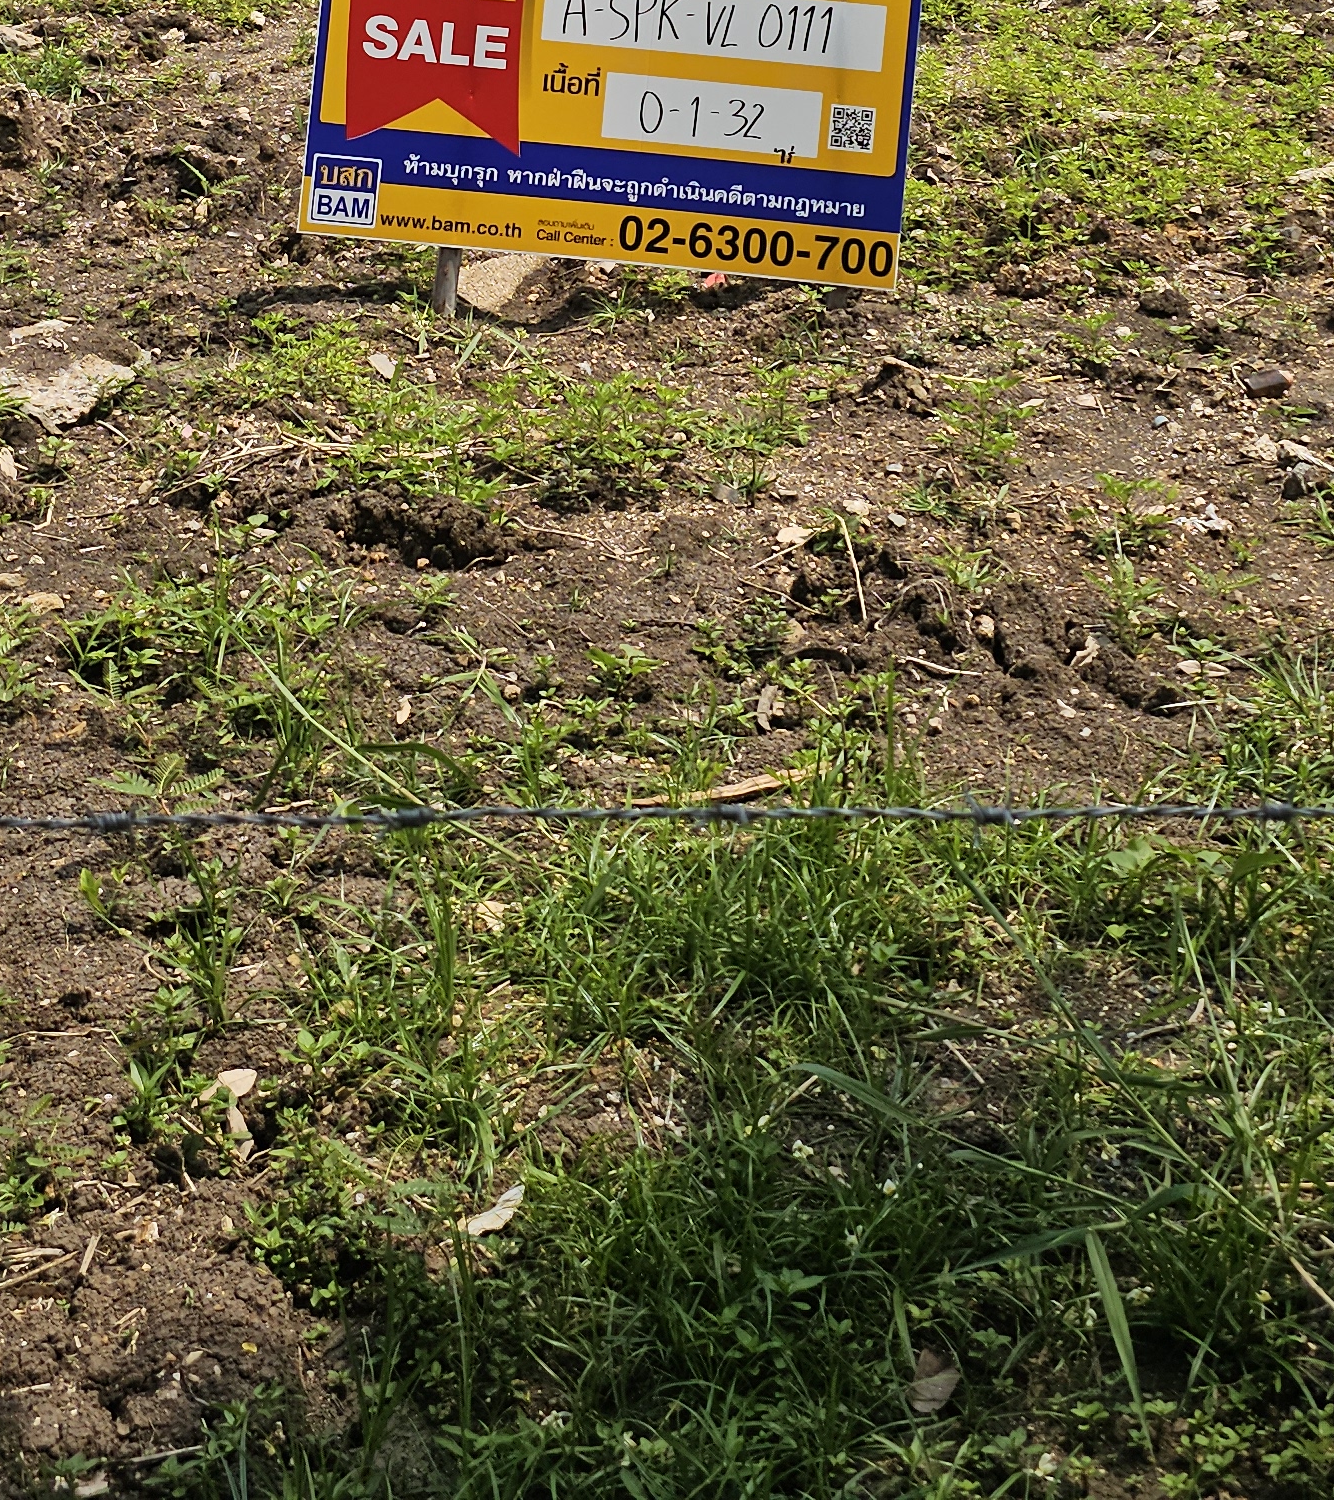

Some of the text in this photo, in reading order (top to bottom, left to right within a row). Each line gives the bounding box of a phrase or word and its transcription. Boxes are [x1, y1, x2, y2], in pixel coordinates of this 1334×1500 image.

[362, 14, 510, 70] SALE
[758, 2, 834, 54] 0111
[542, 62, 601, 97] เนื้อที่
[639, 90, 765, 140] 0-1-32
[320, 164, 374, 189] บสก
[403, 153, 498, 188] ห้ามบุกรุก
[316, 193, 371, 220] BAM
[380, 212, 523, 240] www.bam.co.th
[536, 228, 561, 242] Call
[564, 231, 607, 247] Center
[619, 214, 894, 278] 02-6300-700
